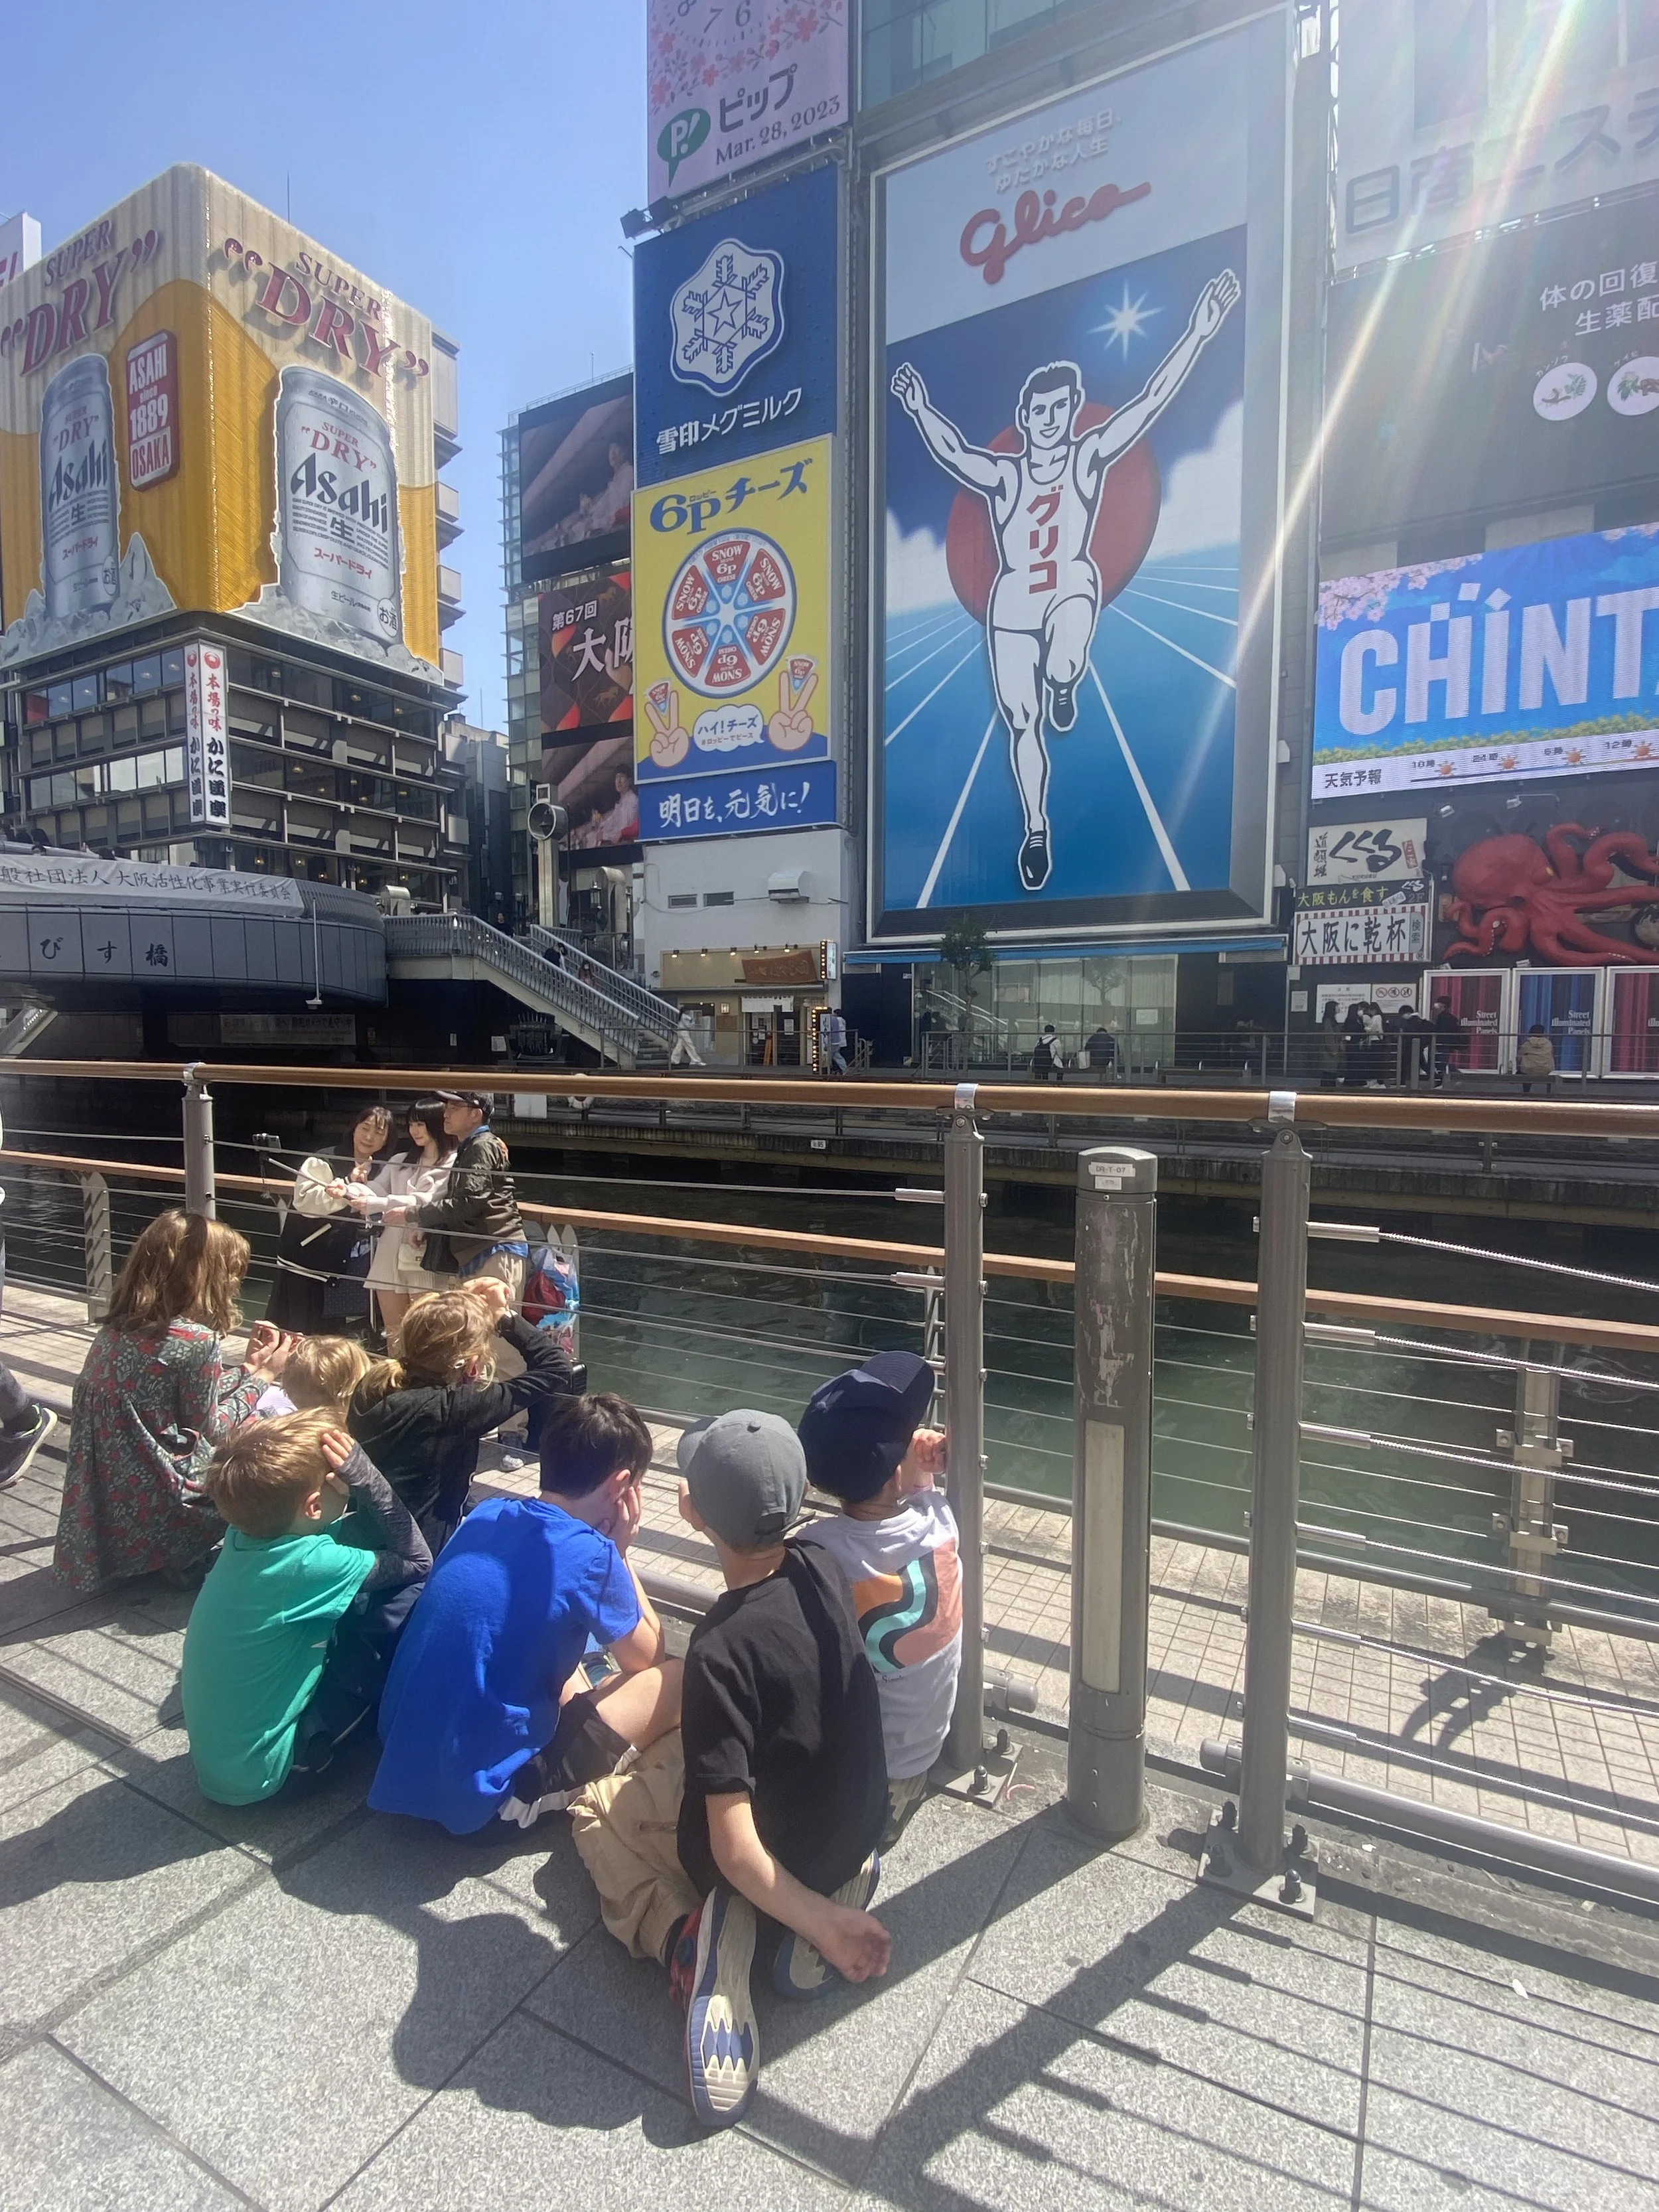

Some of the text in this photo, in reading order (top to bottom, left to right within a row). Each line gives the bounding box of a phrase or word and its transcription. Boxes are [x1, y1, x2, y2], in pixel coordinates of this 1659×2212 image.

[703, 8, 723, 33] 7
[735, 0, 751, 27] 6
[720, 63, 798, 133] ピップ
[716, 94, 841, 166] Mar. 28, 2023
[997, 135, 1109, 194] ゆたかな人生
[44, 218, 112, 287] SUPER
[295, 252, 383, 321] SUPER
[1540, 261, 1658, 311] 体の回復
[129, 342, 167, 395] ASAHI
[130, 394, 169, 441] 1889
[322, 421, 359, 448] SUPER
[656, 387, 802, 455] 雪印メグミルク
[132, 431, 171, 480] OSAKA
[48, 439, 108, 513] Asahi
[291, 453, 388, 534] Asahi
[689, 489, 717, 502] ロッピー
[71, 502, 86, 526] 生
[330, 516, 355, 544] 生
[62, 536, 98, 561] スーパードライ
[712, 544, 743, 561] SNOW
[1027, 484, 1064, 596] グリコ
[314, 547, 372, 579] スーパードライ
[760, 557, 782, 591] SNOW
[676, 573, 695, 611] SNOW
[552, 600, 597, 631] 第67回
[675, 636, 697, 669] SNOW
[760, 617, 782, 657] SNOW
[712, 668, 742, 684] SNOW
[1339, 583, 1659, 736] CHINT
[188, 672, 198, 729] 本場の味
[206, 673, 222, 731] 本場の味
[206, 737, 226, 818] かに道楽
[1325, 768, 1382, 790] 天気予報
[1329, 829, 1402, 873] くくる
[1297, 886, 1389, 908] 大阪もんを食す
[1402, 880, 1425, 892] くくる
[1409, 892, 1425, 903] 2F
[1301, 915, 1406, 956] 大阪に乾杯
[1411, 919, 1421, 944] 検索
[1461, 1017, 1498, 1027] Illuminated
[1476, 1010, 1497, 1019] Street
[1551, 1017, 1591, 1027] Illuminated
[1568, 1009, 1590, 1019] Street
